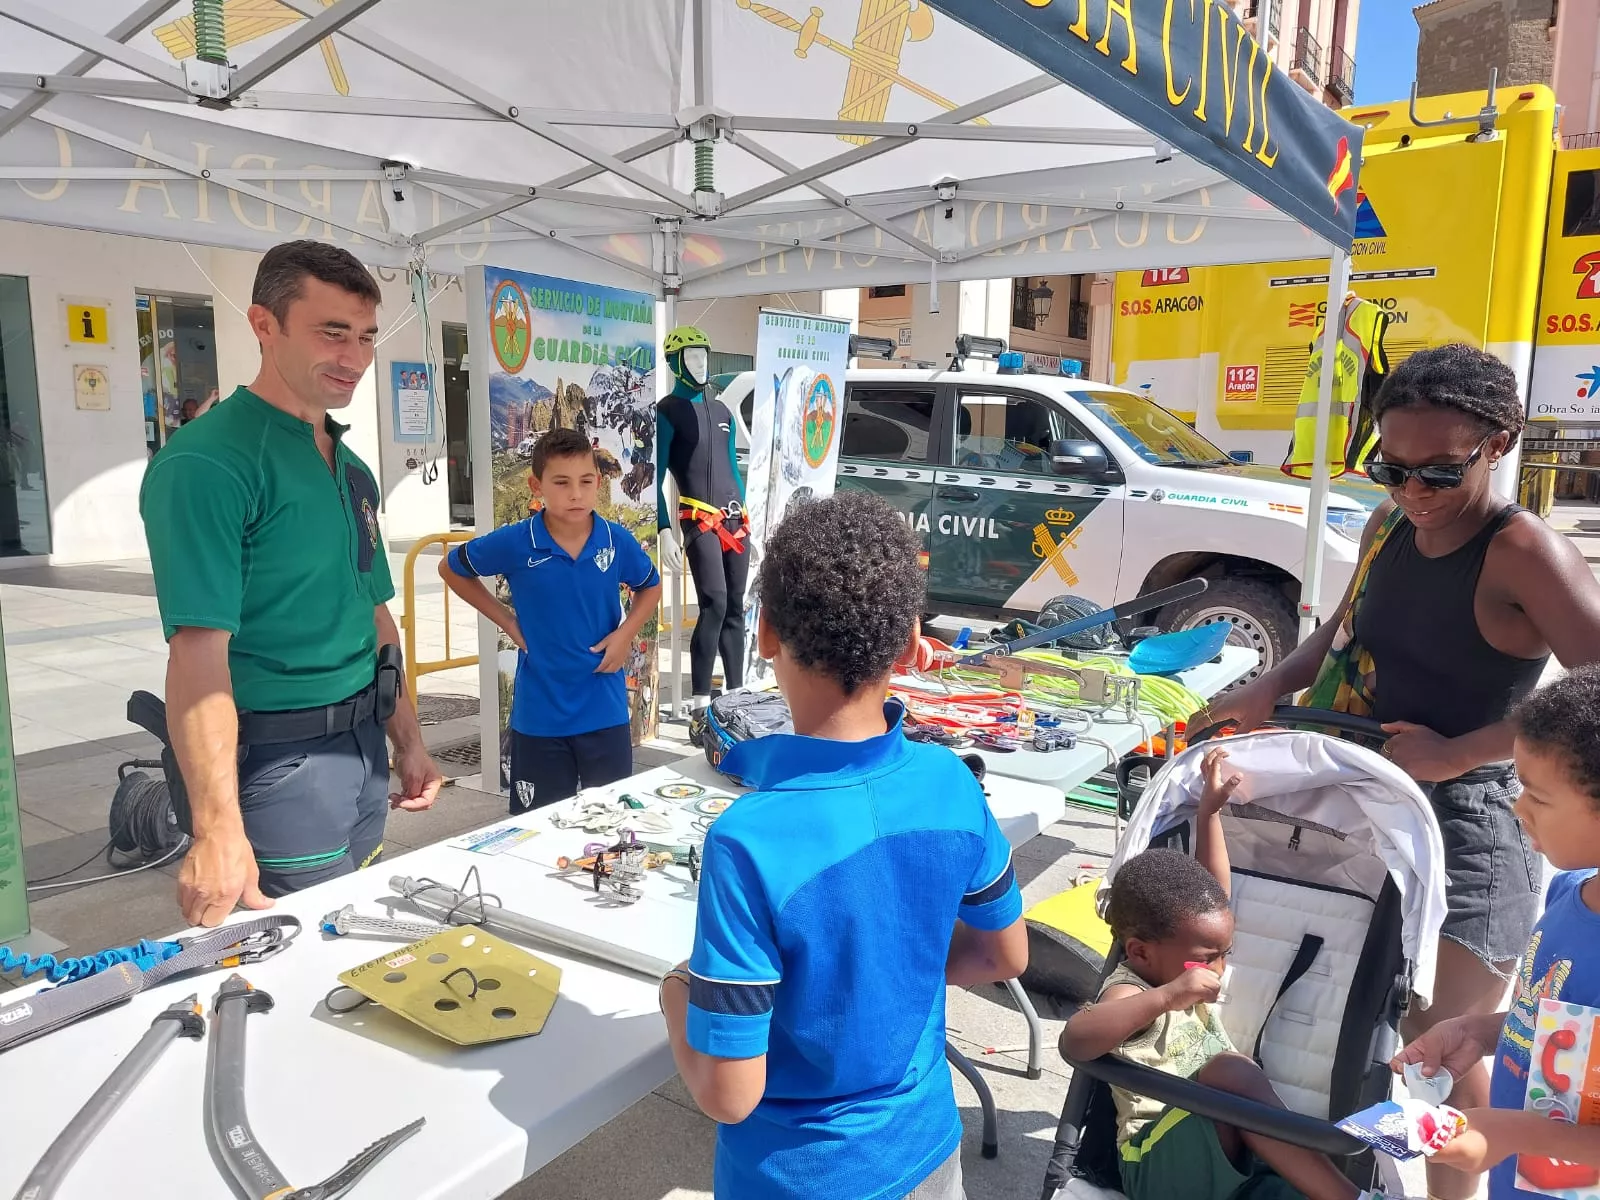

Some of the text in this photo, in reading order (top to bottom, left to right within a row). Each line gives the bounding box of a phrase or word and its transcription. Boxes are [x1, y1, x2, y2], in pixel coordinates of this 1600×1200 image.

[1162, 0, 1280, 169] CIVIL
[530, 287, 653, 324] SERVICIO DE MONTAÑA
[1120, 298, 1154, 317] S.O.S.
[582, 324, 602, 336] DE LA
[1546, 313, 1594, 334] S.O.S.
[533, 337, 652, 371] GUARDIA CIVIL
[1229, 368, 1256, 383] 112
[1228, 382, 1255, 392] Aragón
[1537, 404, 1567, 414] Obra
[1168, 493, 1249, 507] GUARDIA CIVIL
[938, 514, 999, 539] CIVIL
